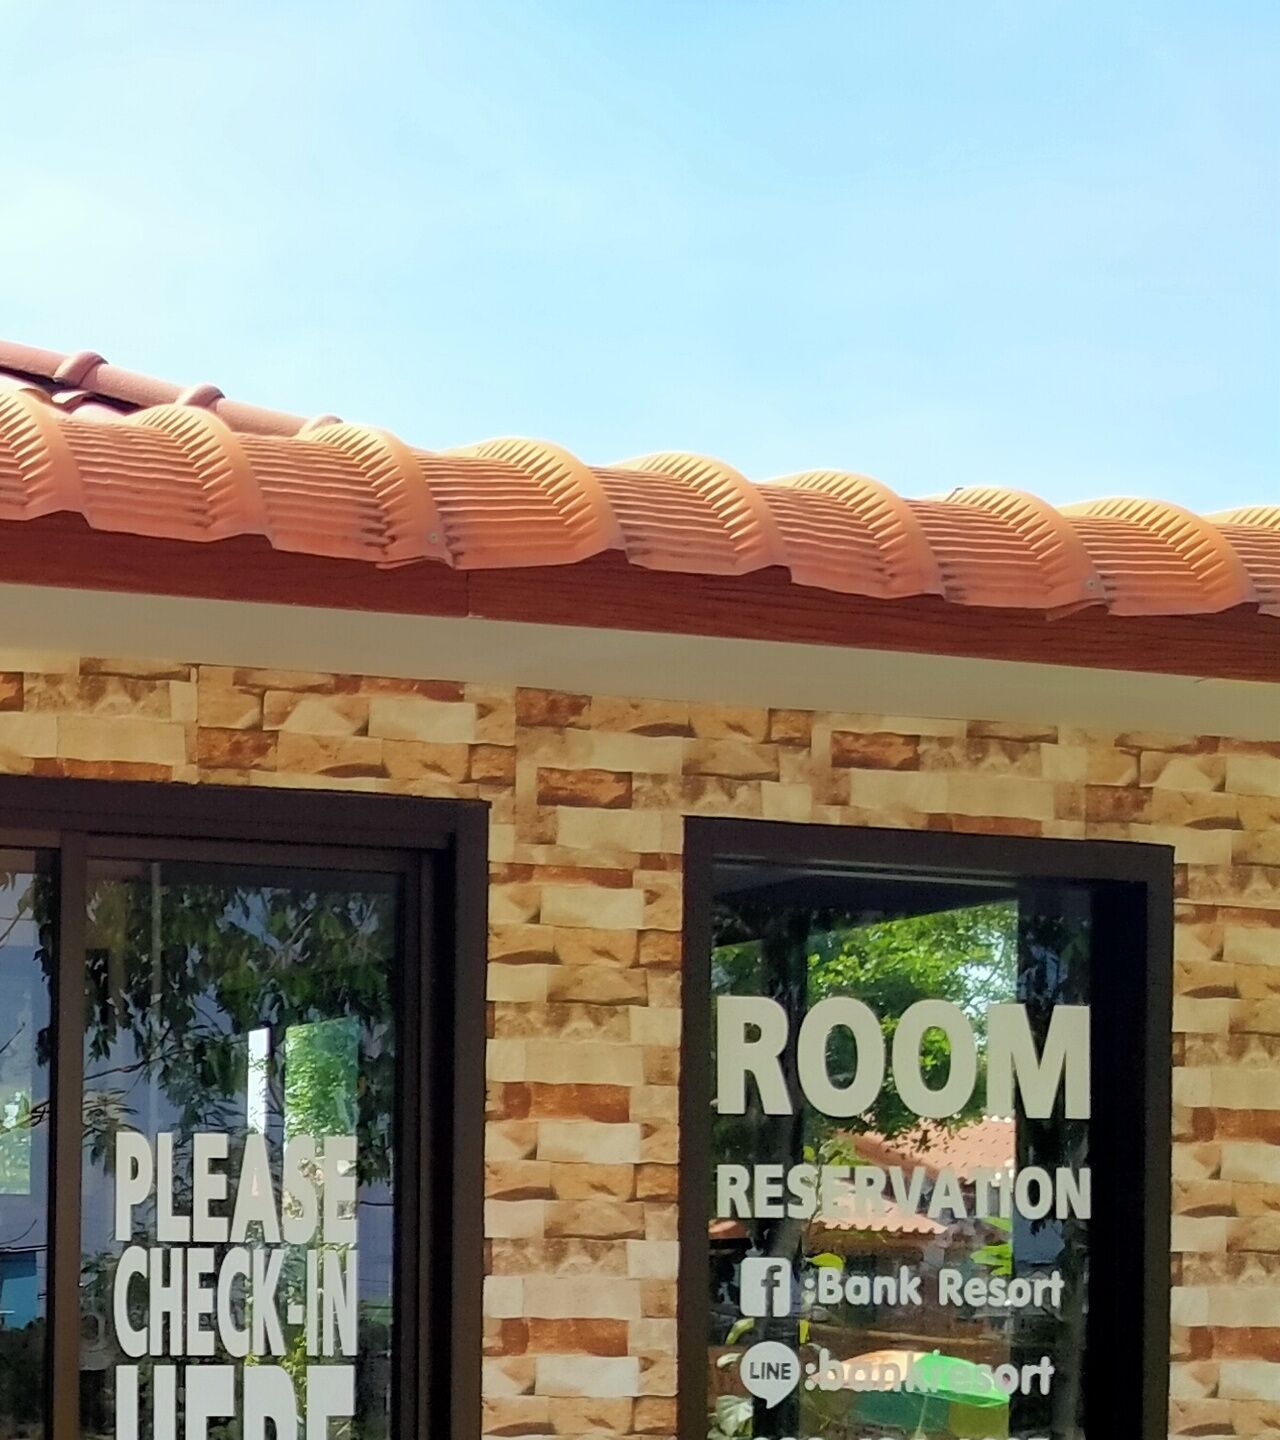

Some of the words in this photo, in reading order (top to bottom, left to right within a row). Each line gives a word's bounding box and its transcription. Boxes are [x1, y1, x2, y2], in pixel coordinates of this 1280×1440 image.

[715, 995, 1092, 1120] ROOM
[115, 1131, 358, 1245] PLEASE
[715, 1163, 1092, 1221] RESERVATION
[113, 1245, 358, 1358] CHECK-IN
[938, 1267, 1066, 1308] Resort
[749, 1361, 792, 1380] LINE
